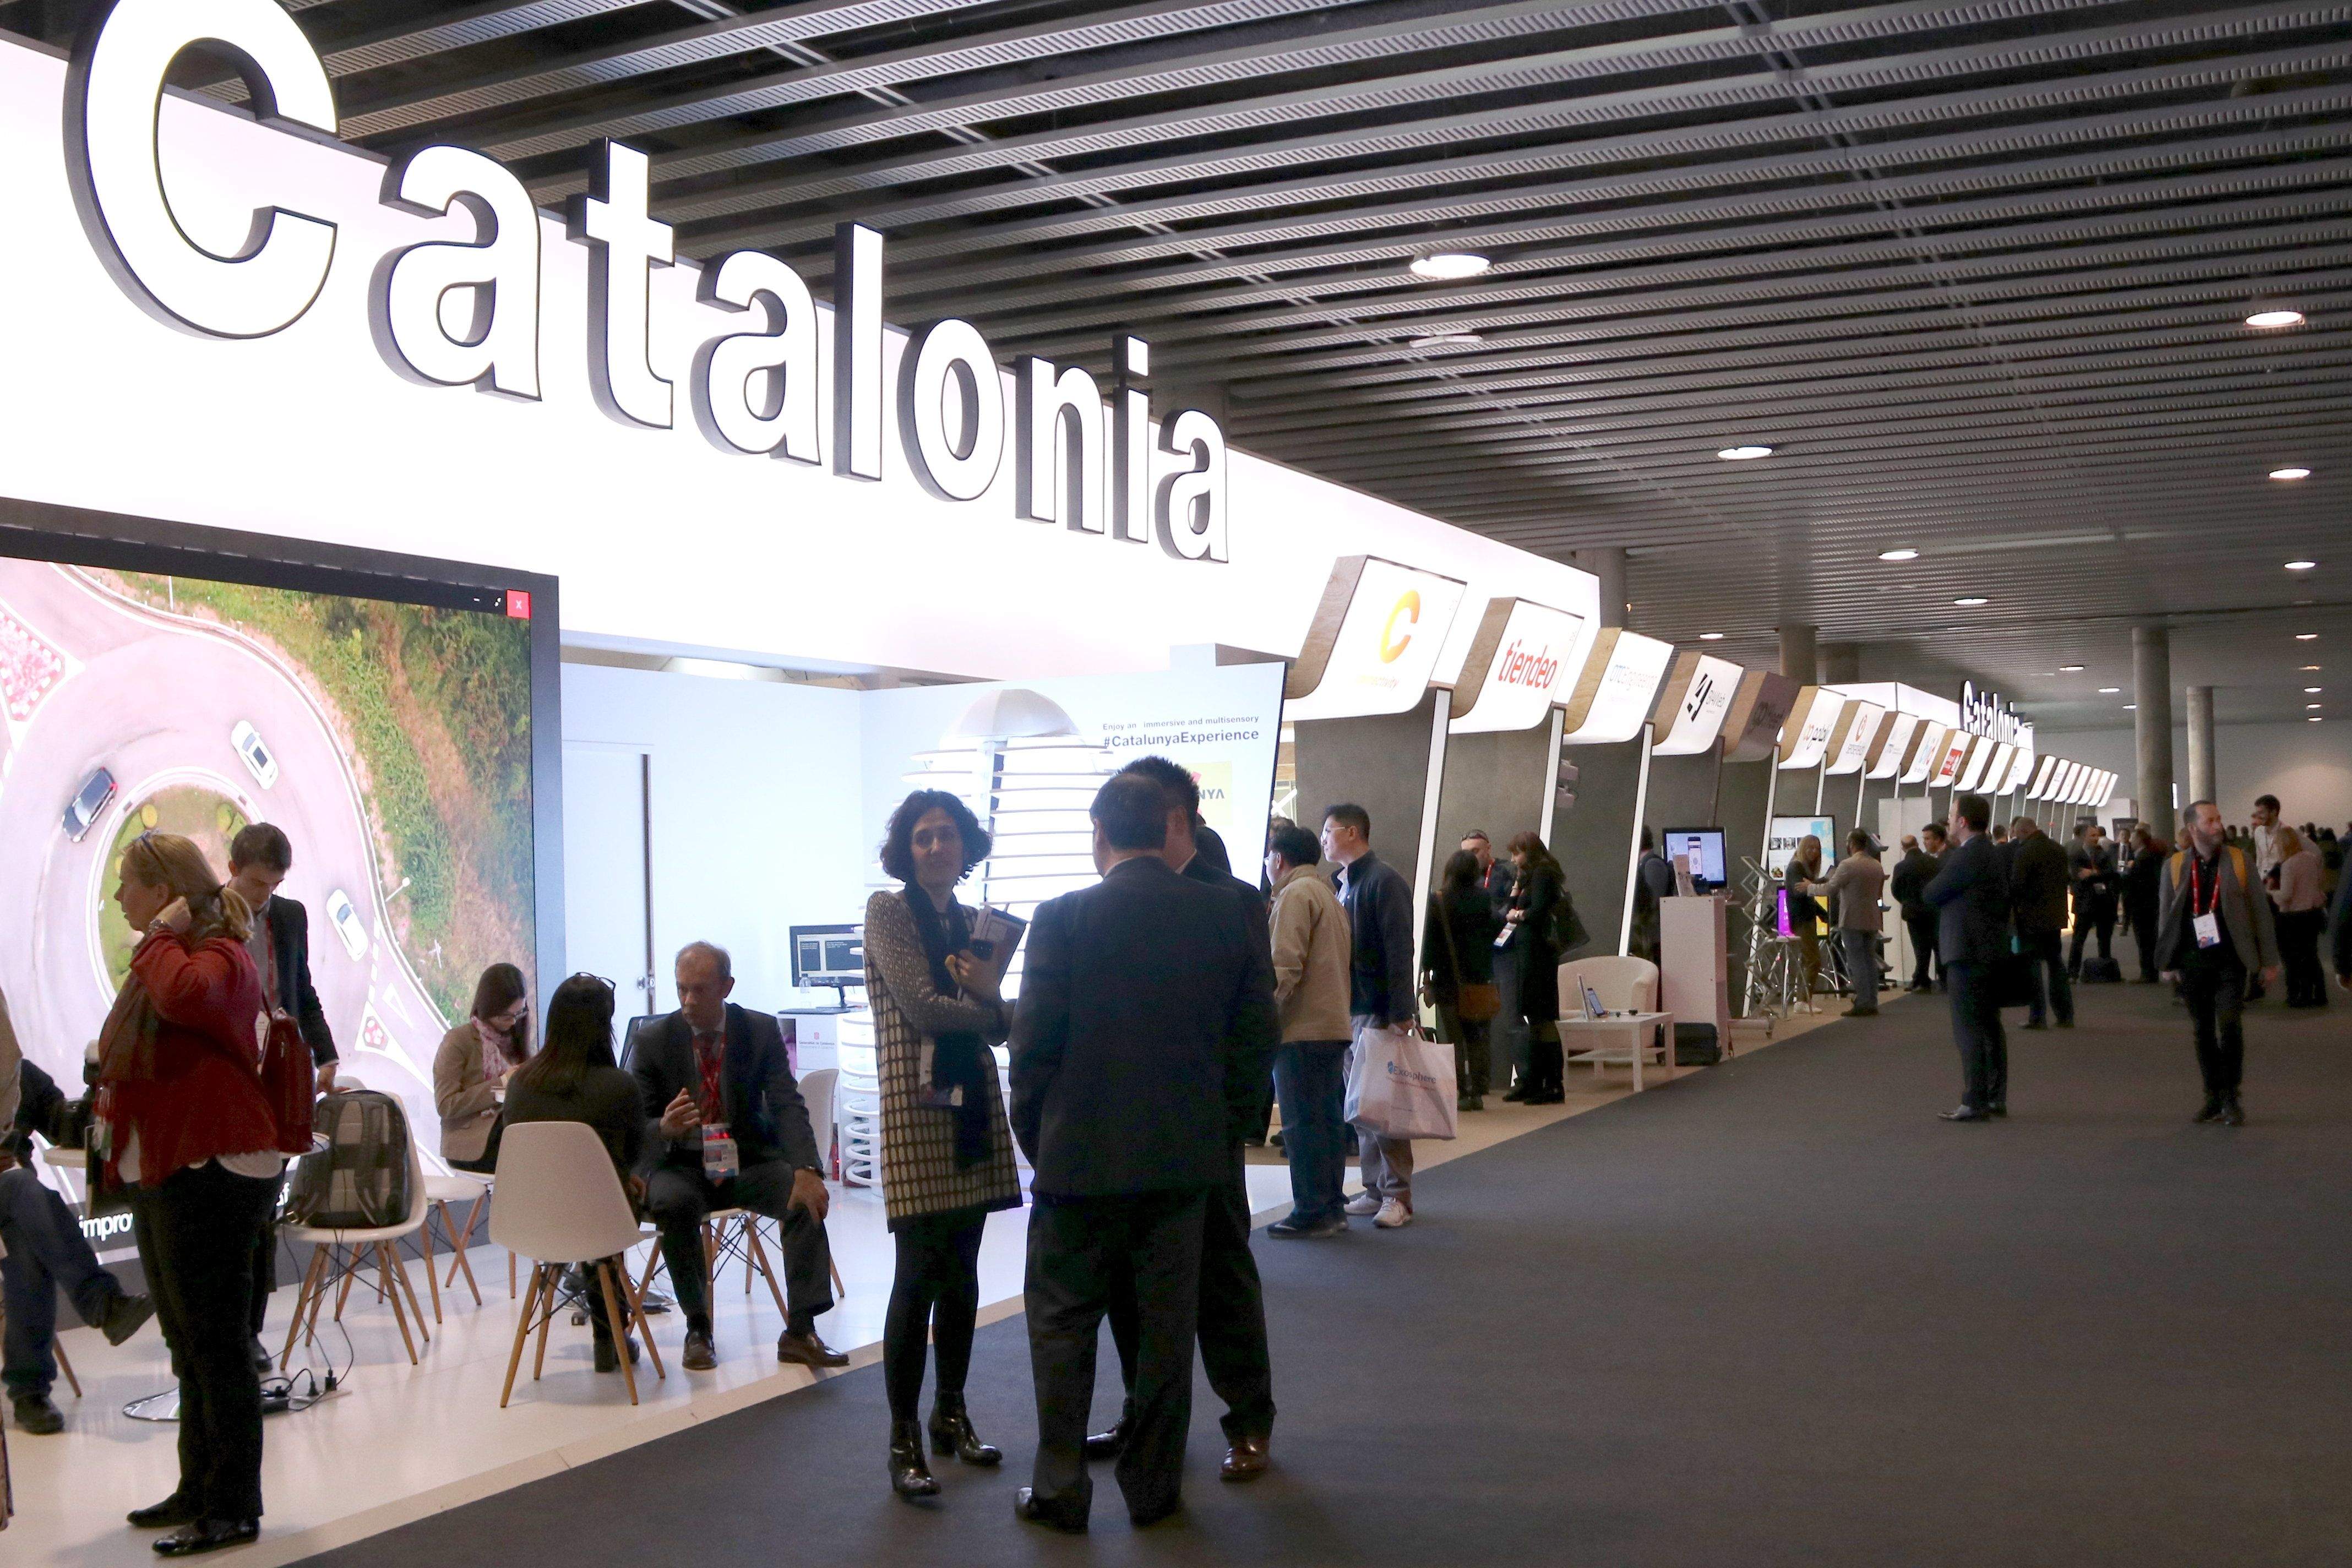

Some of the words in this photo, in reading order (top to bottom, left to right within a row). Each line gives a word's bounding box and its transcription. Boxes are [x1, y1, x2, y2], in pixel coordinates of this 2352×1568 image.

[62, 0, 1228, 563] Catalonia
[1498, 639, 1558, 689] tiendeo
[1103, 723, 1124, 731] Enjoy
[1144, 720, 1185, 728] immersive
[1205, 716, 1260, 726] multisensory
[1960, 679, 2022, 748] Catalonia
[1104, 729, 1260, 747] #CatalunyaExperience
[1394, 1066, 1436, 1084] Exosphere
